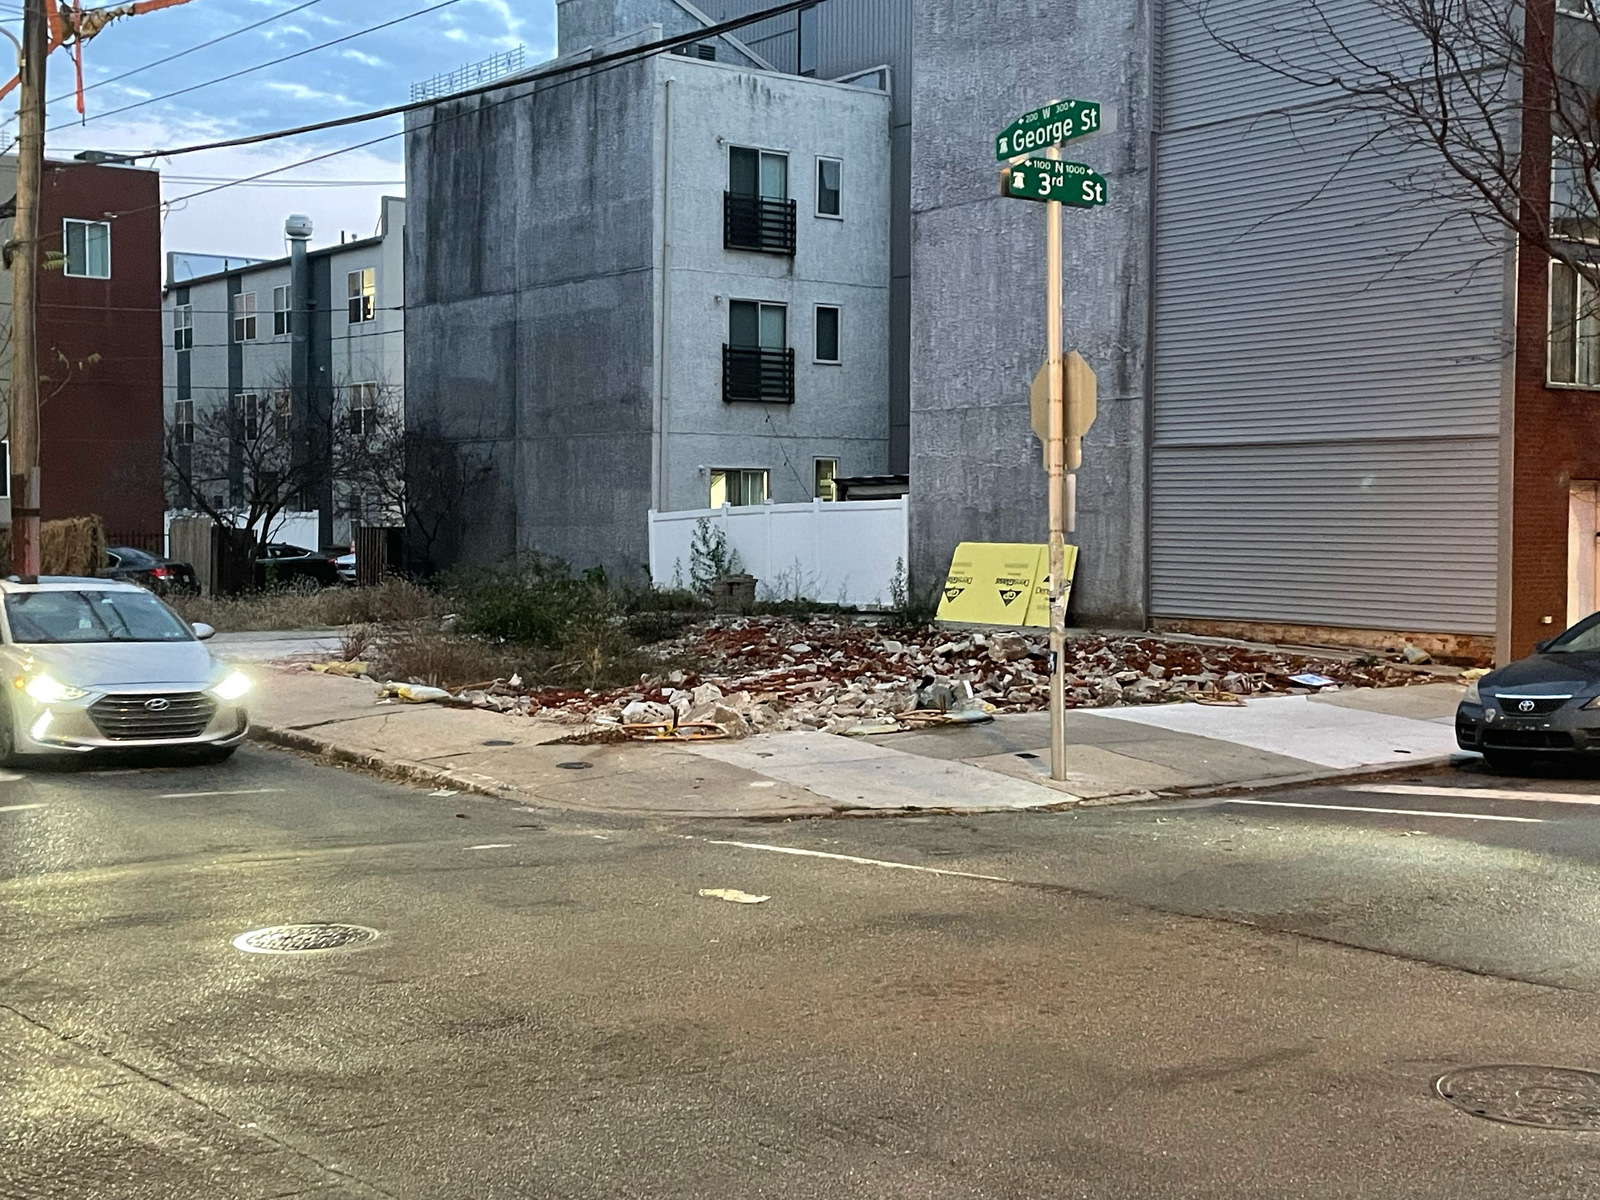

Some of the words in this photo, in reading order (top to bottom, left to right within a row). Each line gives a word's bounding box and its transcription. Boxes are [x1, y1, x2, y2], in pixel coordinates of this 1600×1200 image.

[1025, 112, 1038, 123] 200
[1042, 107, 1051, 120] W
[1055, 102, 1069, 114] 300
[1013, 118, 1073, 151] George
[1081, 108, 1098, 131] St
[1033, 160, 1051, 170] 1100
[1055, 162, 1064, 174] N
[1065, 165, 1085, 175] 1000
[1038, 173, 1064, 195] 3rd
[1081, 180, 1103, 202] St
